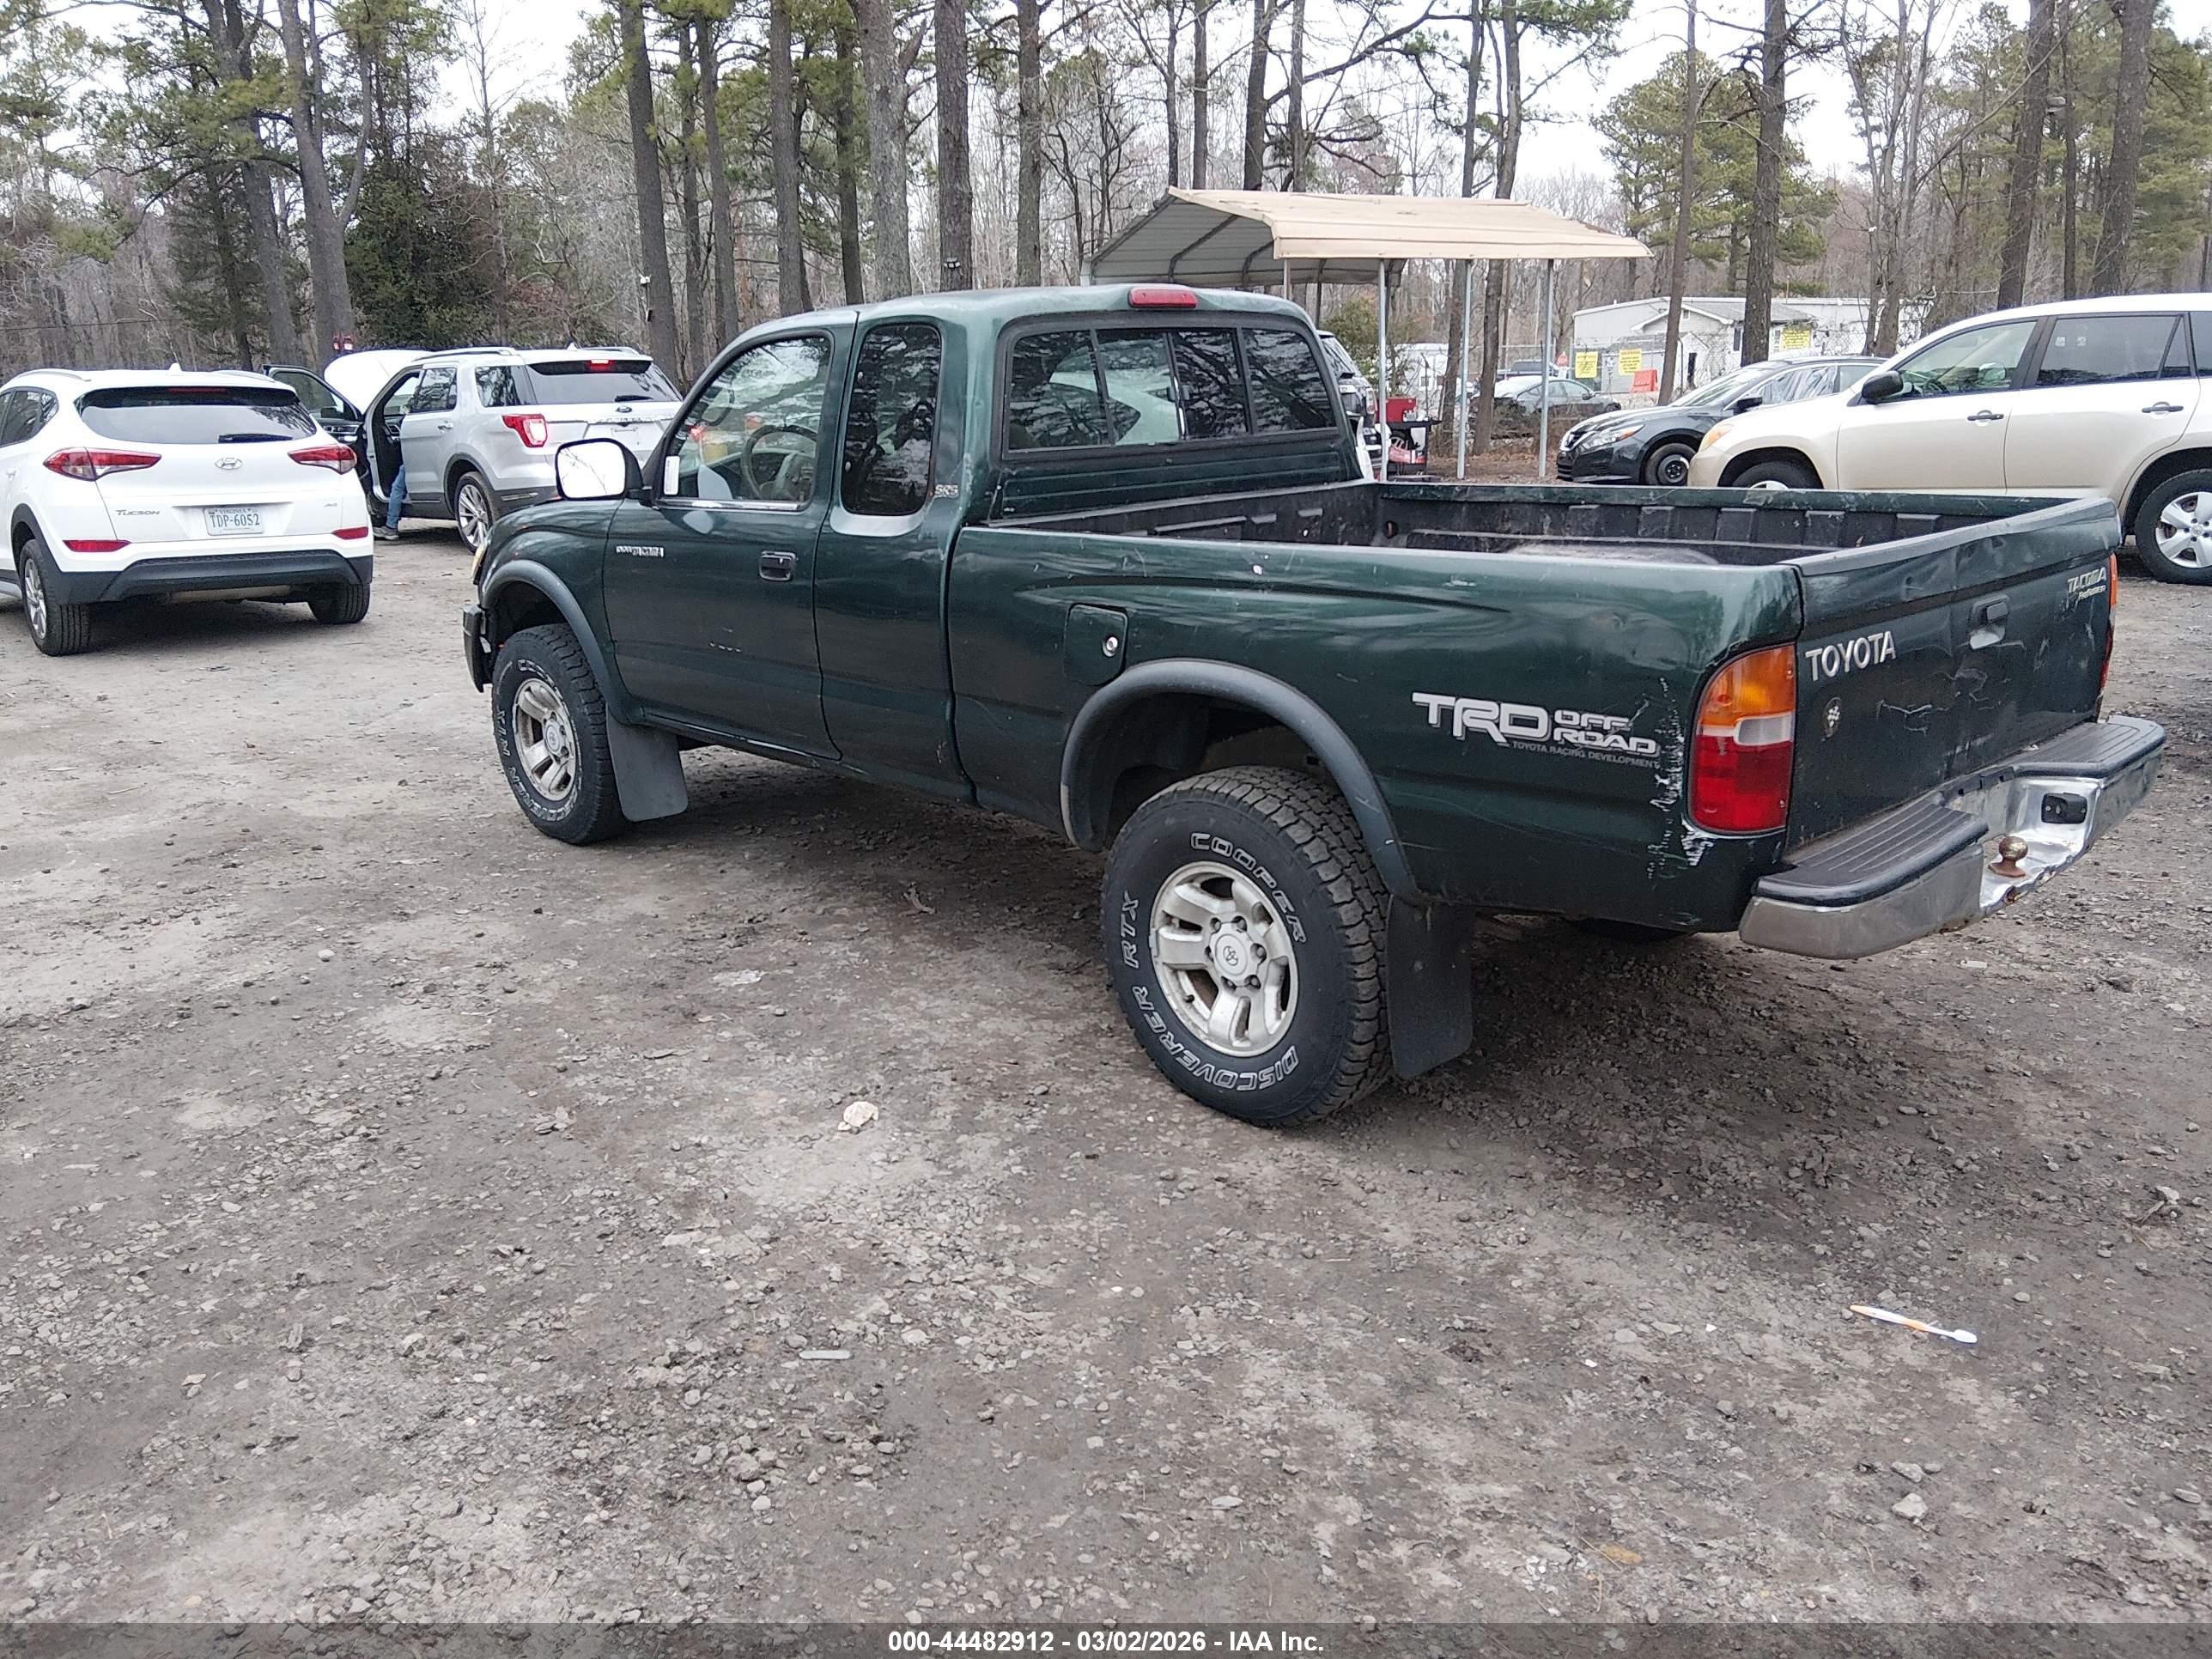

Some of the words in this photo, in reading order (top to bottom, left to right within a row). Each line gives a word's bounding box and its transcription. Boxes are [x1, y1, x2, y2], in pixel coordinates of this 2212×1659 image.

[209, 513, 261, 528] TDP-6052
[1805, 630, 1896, 682] TOYOTA
[1412, 691, 1551, 747] TRD
[1553, 708, 1632, 732] OFF
[1553, 727, 1662, 757] ROAD
[1512, 740, 1548, 753] TOYOTA
[1549, 745, 1586, 759] RACING
[1588, 750, 1662, 769] DEVELOPMENT
[1190, 832, 1307, 944] COOPER
[1120, 890, 1139, 969] RTX
[1131, 985, 1300, 1091] DISCOVERER
